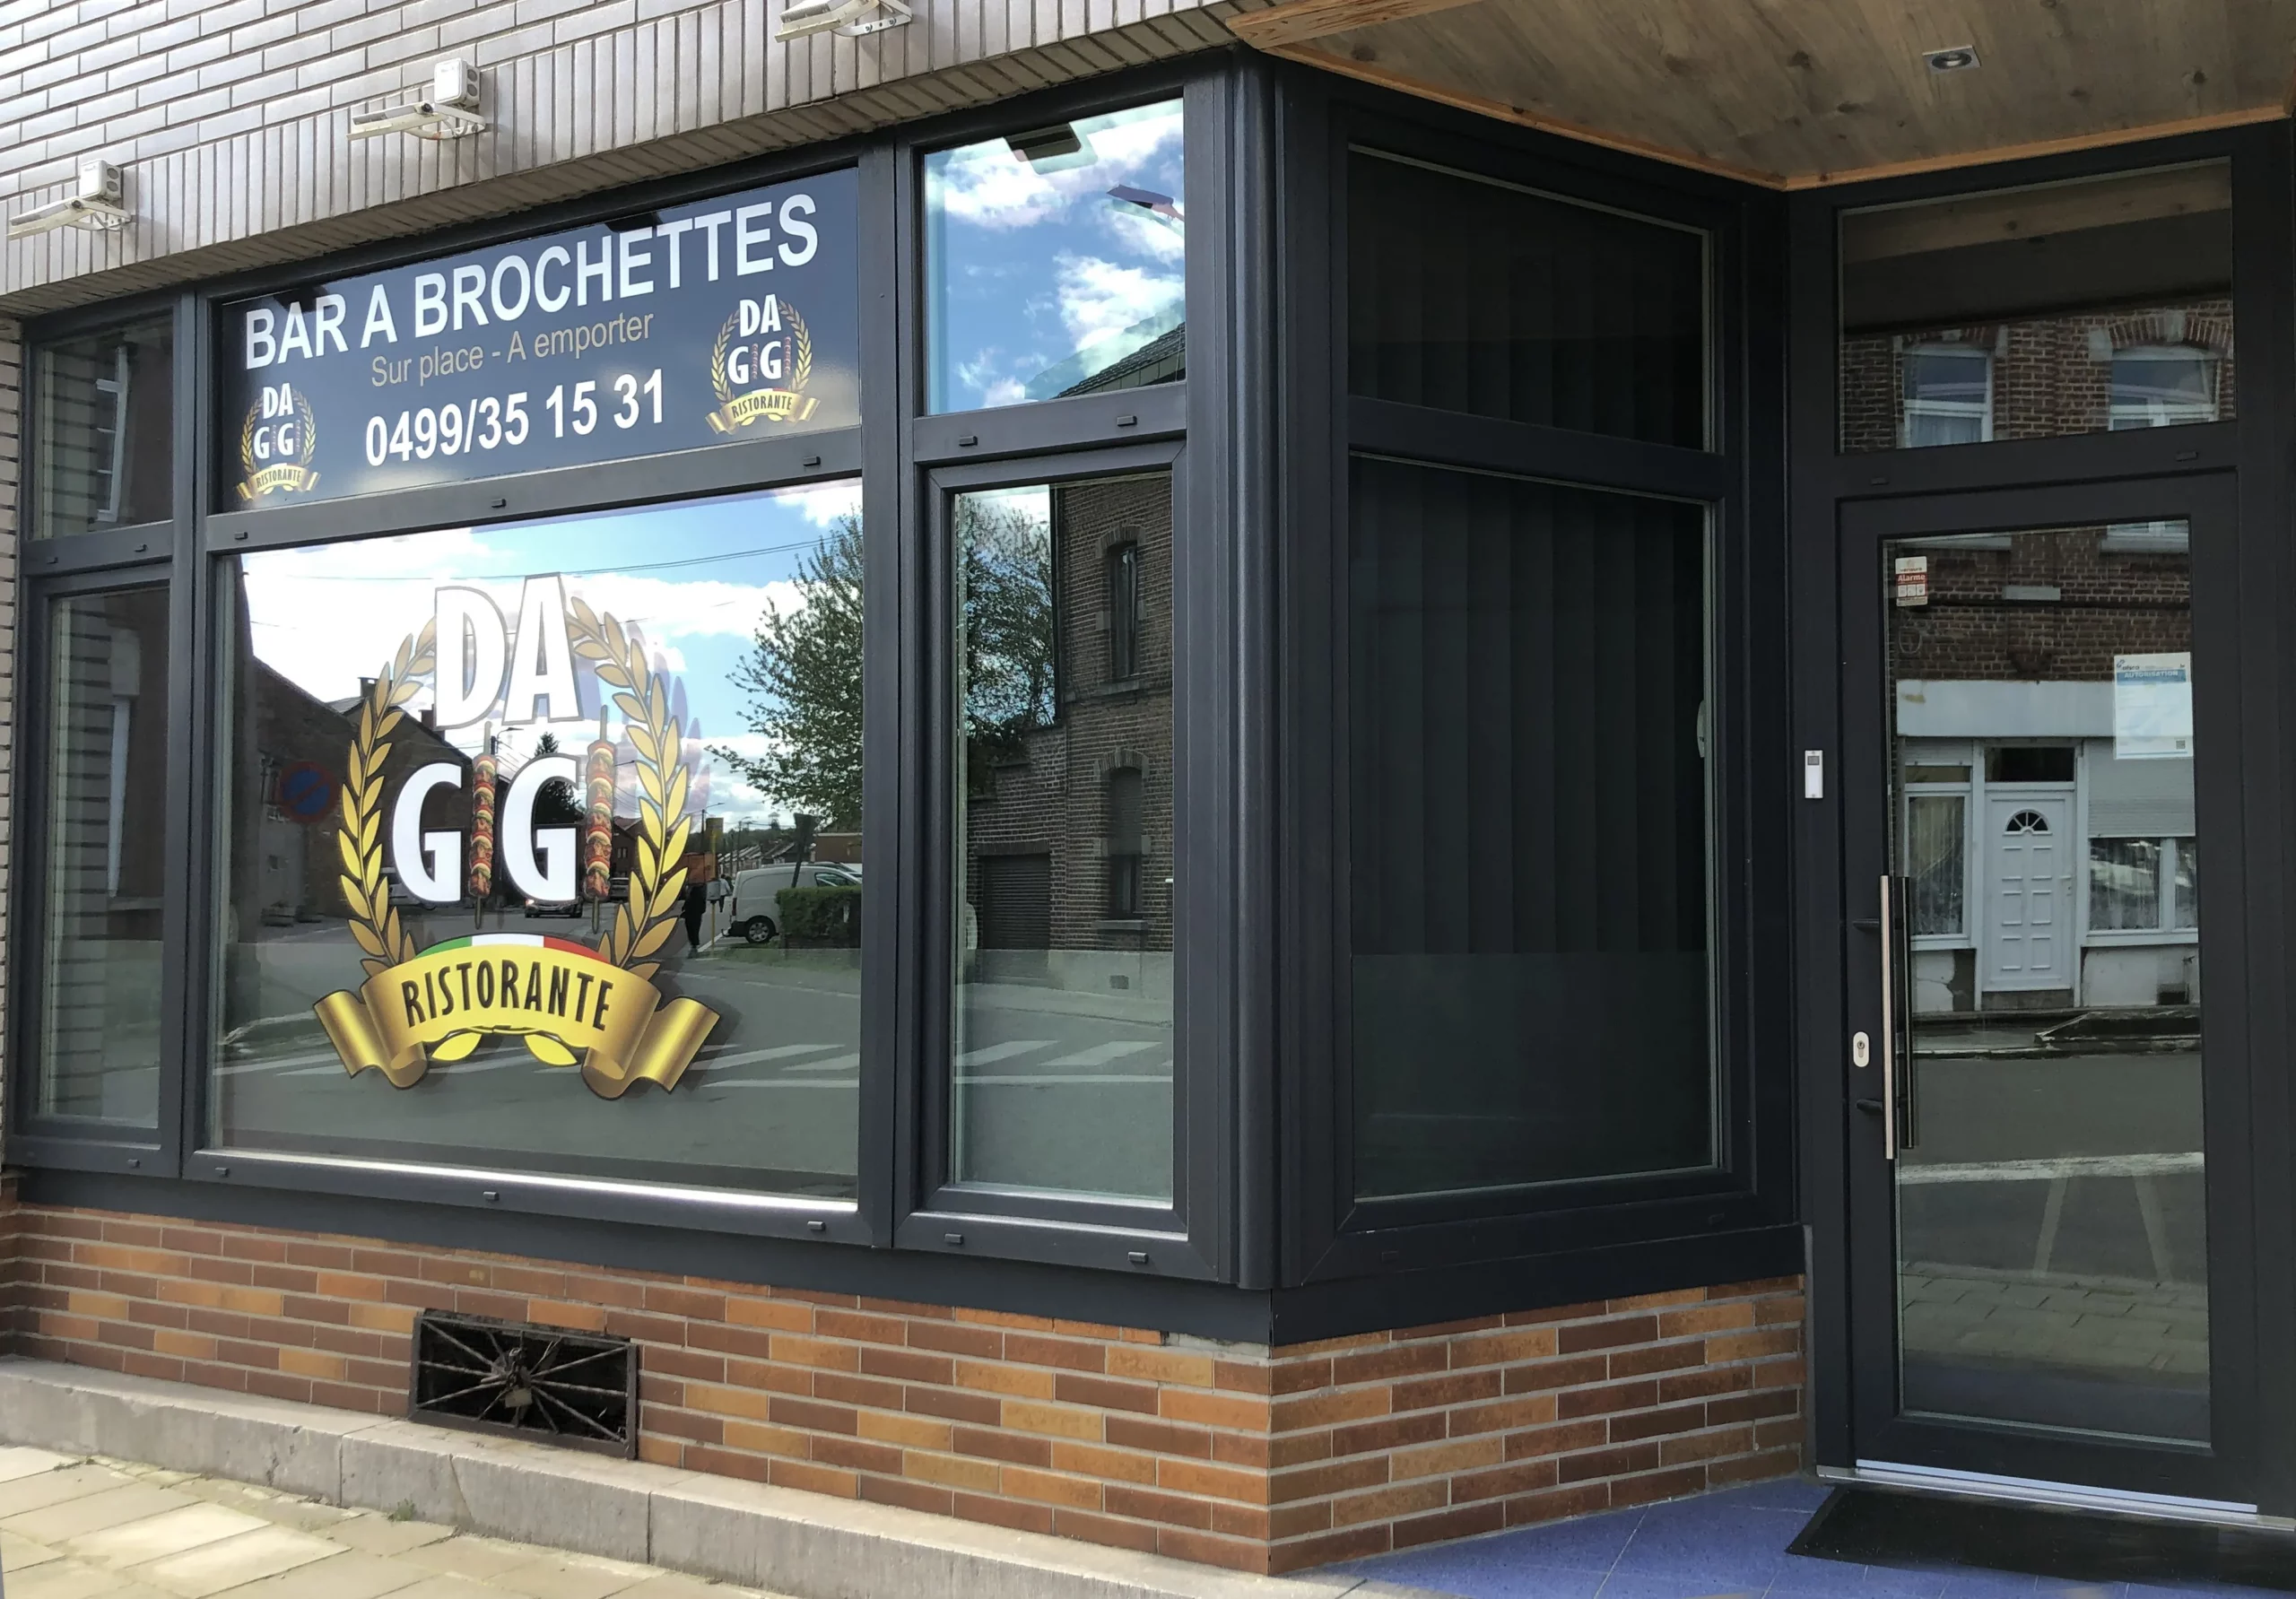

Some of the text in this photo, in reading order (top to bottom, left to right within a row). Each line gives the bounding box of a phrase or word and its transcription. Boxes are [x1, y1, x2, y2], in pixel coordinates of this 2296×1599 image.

[246, 194, 818, 369] BAR A BROCHETTES
[739, 293, 782, 337] DA
[371, 356, 412, 387] Sur
[420, 345, 484, 387] place
[507, 331, 526, 363] A
[535, 312, 654, 360] emporter
[263, 382, 294, 419] DA
[365, 369, 663, 466] 0499/35 15 31
[731, 395, 793, 418] RISTORANTE
[256, 468, 301, 488] RISTORANTE
[1898, 574, 1926, 582] Alarme
[434, 571, 585, 729] DA
[2124, 670, 2179, 679] AUTORISATION
[401, 959, 614, 1031] RISTORANTE
